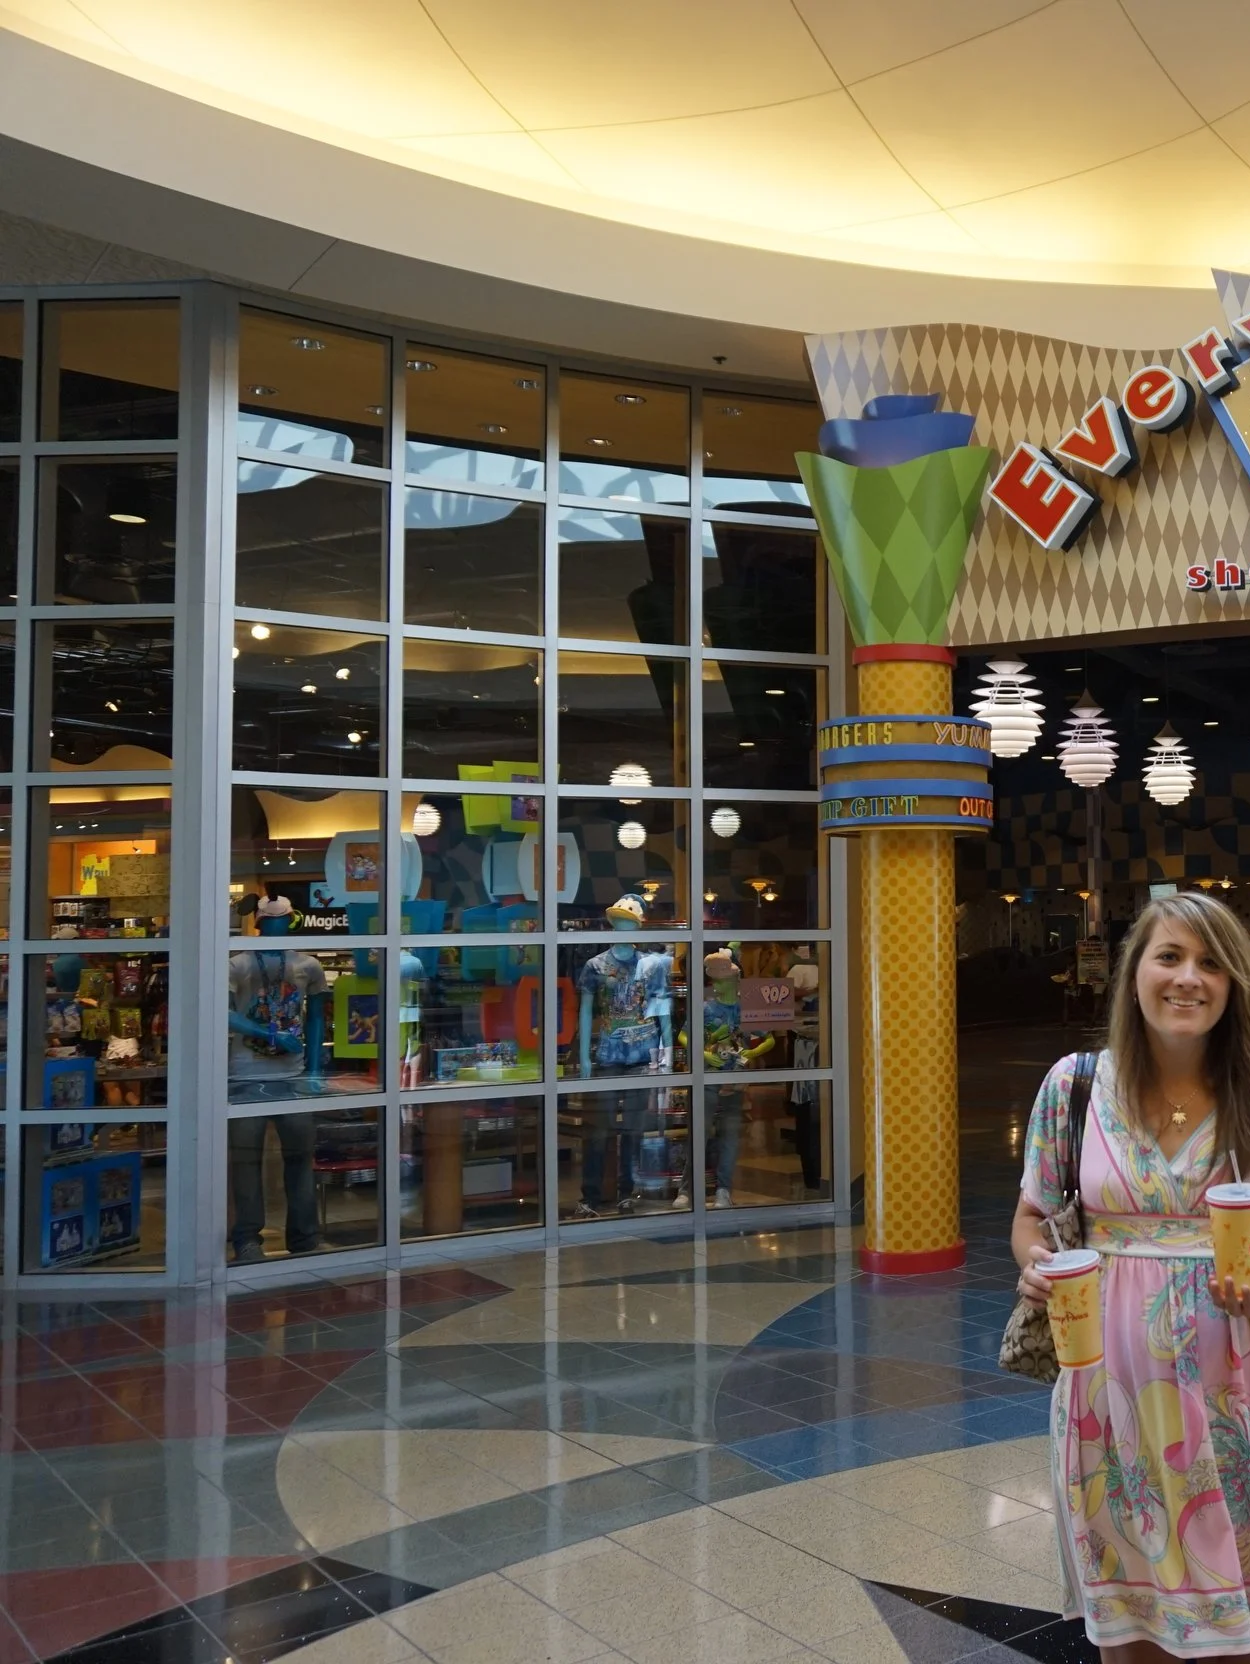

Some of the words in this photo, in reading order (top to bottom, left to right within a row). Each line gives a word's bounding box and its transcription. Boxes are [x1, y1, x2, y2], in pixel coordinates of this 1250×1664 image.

[851, 795, 919, 817] GIFT
[959, 797, 985, 816] OUT
[760, 984, 790, 1004] POP
